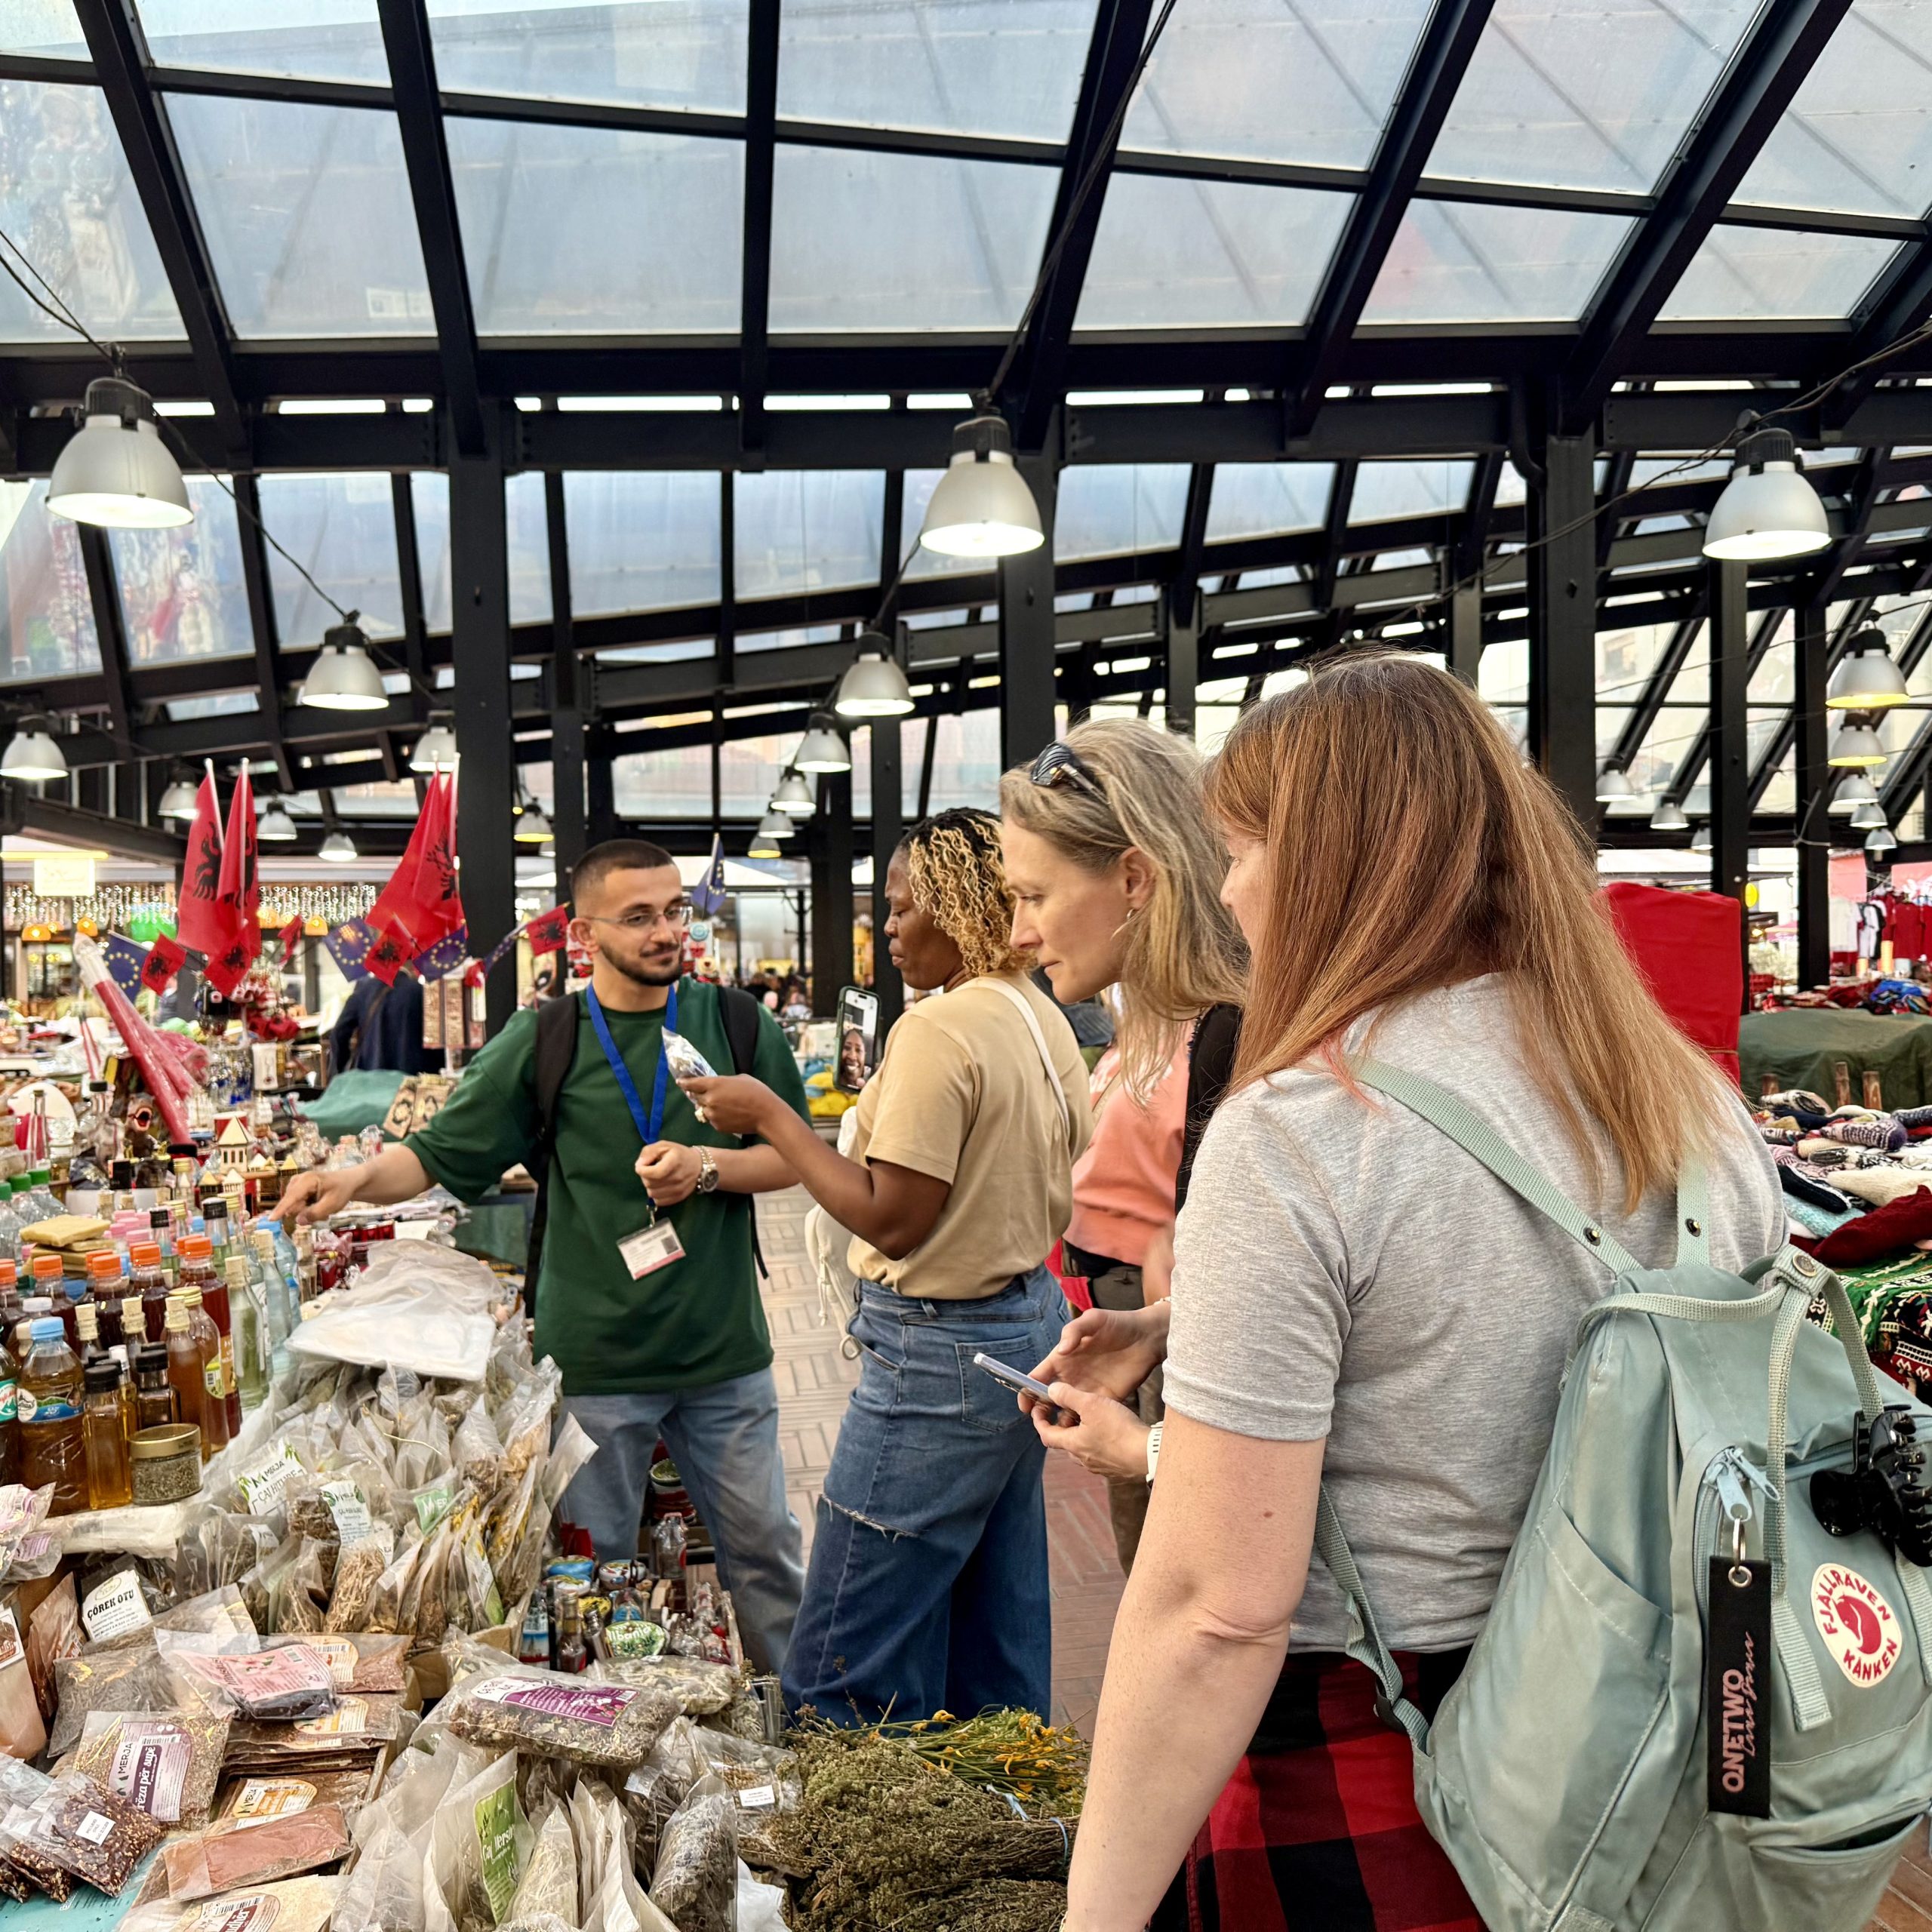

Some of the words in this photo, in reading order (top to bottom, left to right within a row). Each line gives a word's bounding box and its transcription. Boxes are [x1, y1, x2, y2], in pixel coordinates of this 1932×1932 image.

[87, 1598, 115, 1621] ÇÖREK
[117, 1589, 134, 1604] OTU
[1816, 1570, 1891, 1635] FJÄLLRÄVEN
[1843, 1638, 1898, 1681] KÅNKEN
[1721, 1668, 1745, 1794] ONETWO
[118, 1743, 134, 1774] MERJA
[138, 1767, 152, 1786] për
[135, 1784, 148, 1811] rëza
